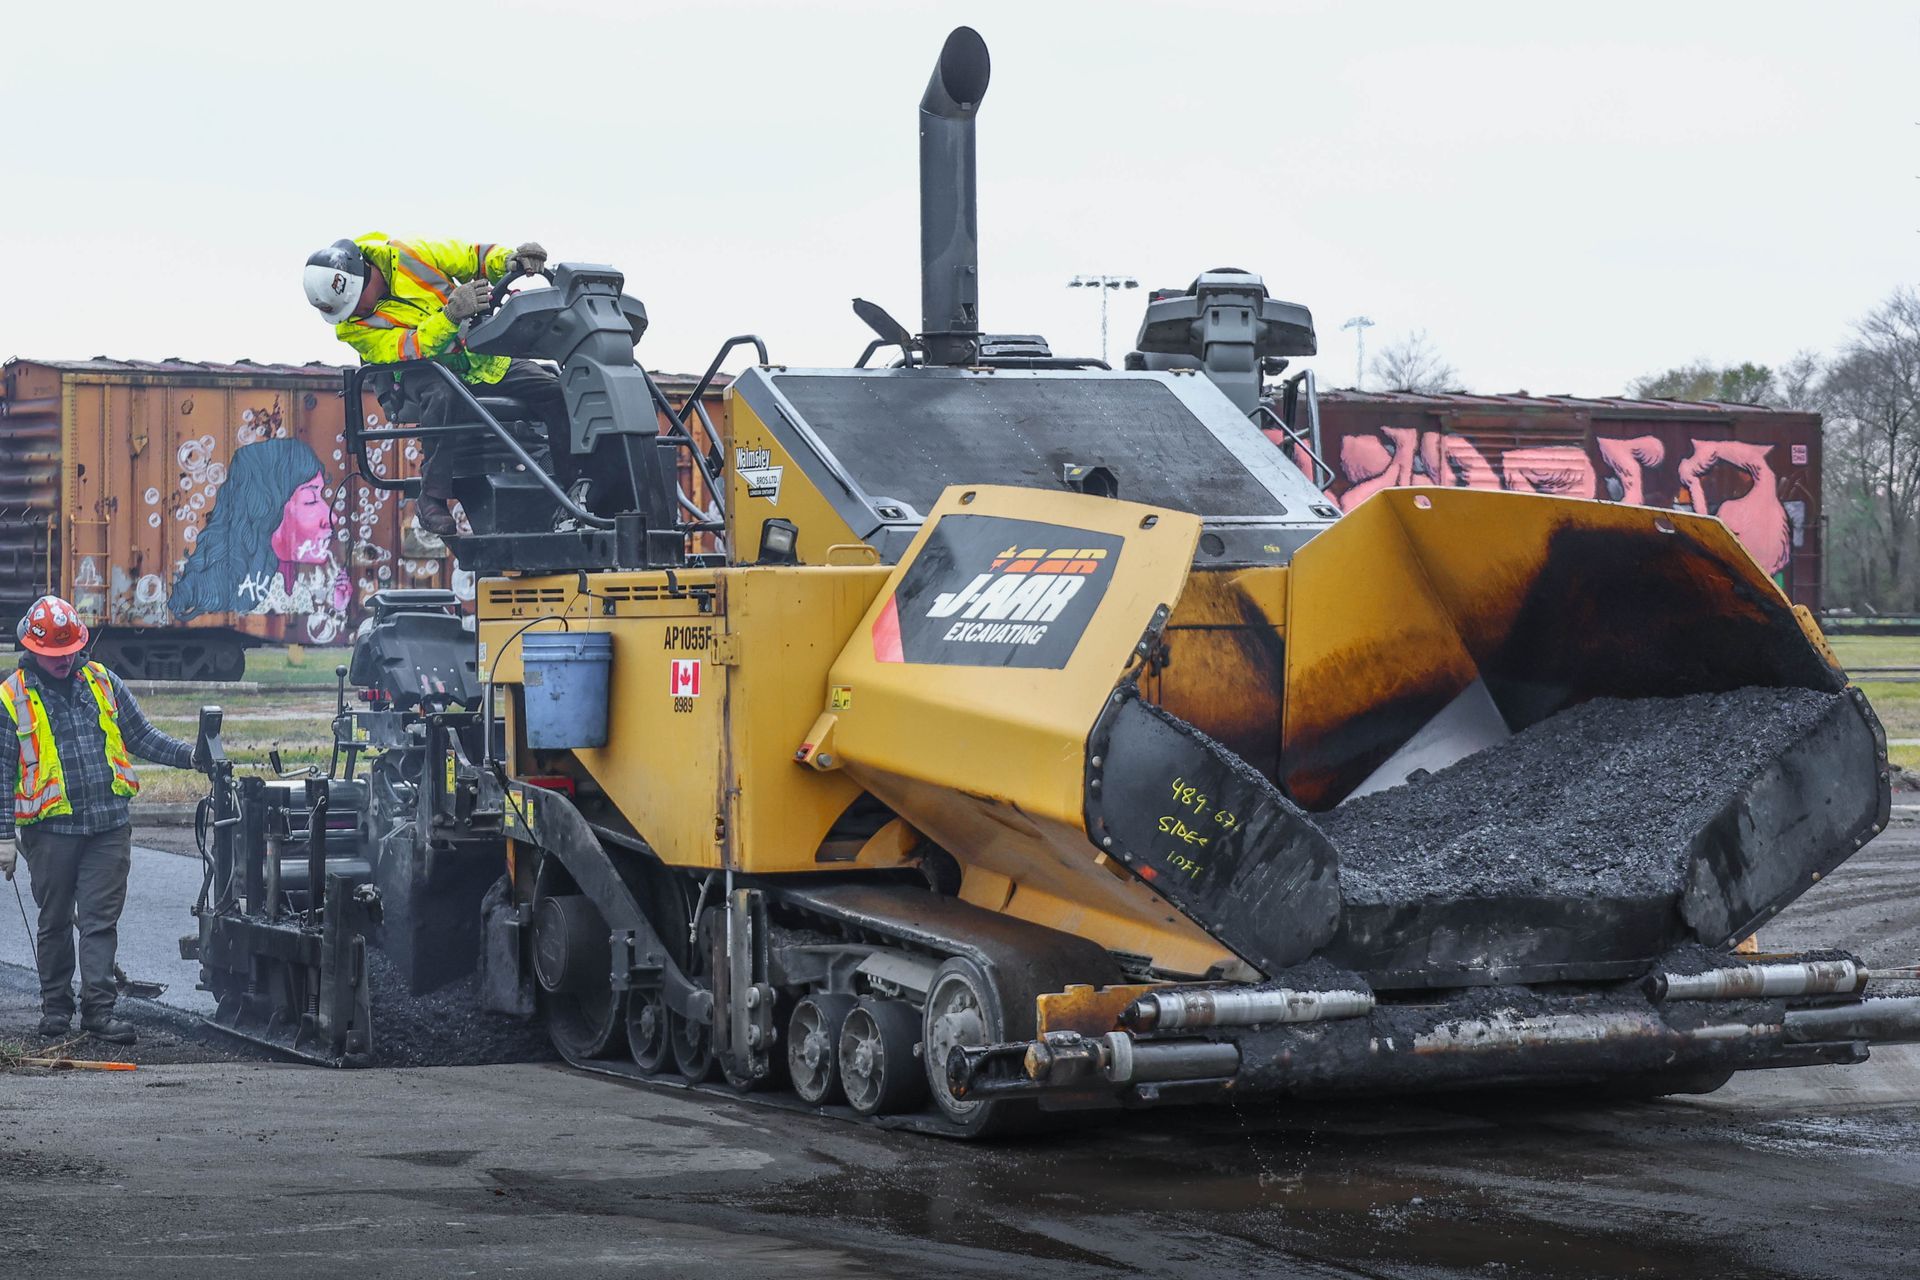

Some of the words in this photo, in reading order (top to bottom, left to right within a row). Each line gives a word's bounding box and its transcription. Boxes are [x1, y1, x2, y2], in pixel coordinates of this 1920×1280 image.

[735, 445, 771, 470] Walmsley
[664, 626, 712, 650] AP1055F
[943, 622, 1048, 645] EXCAVATING
[674, 697, 693, 713] 8989
